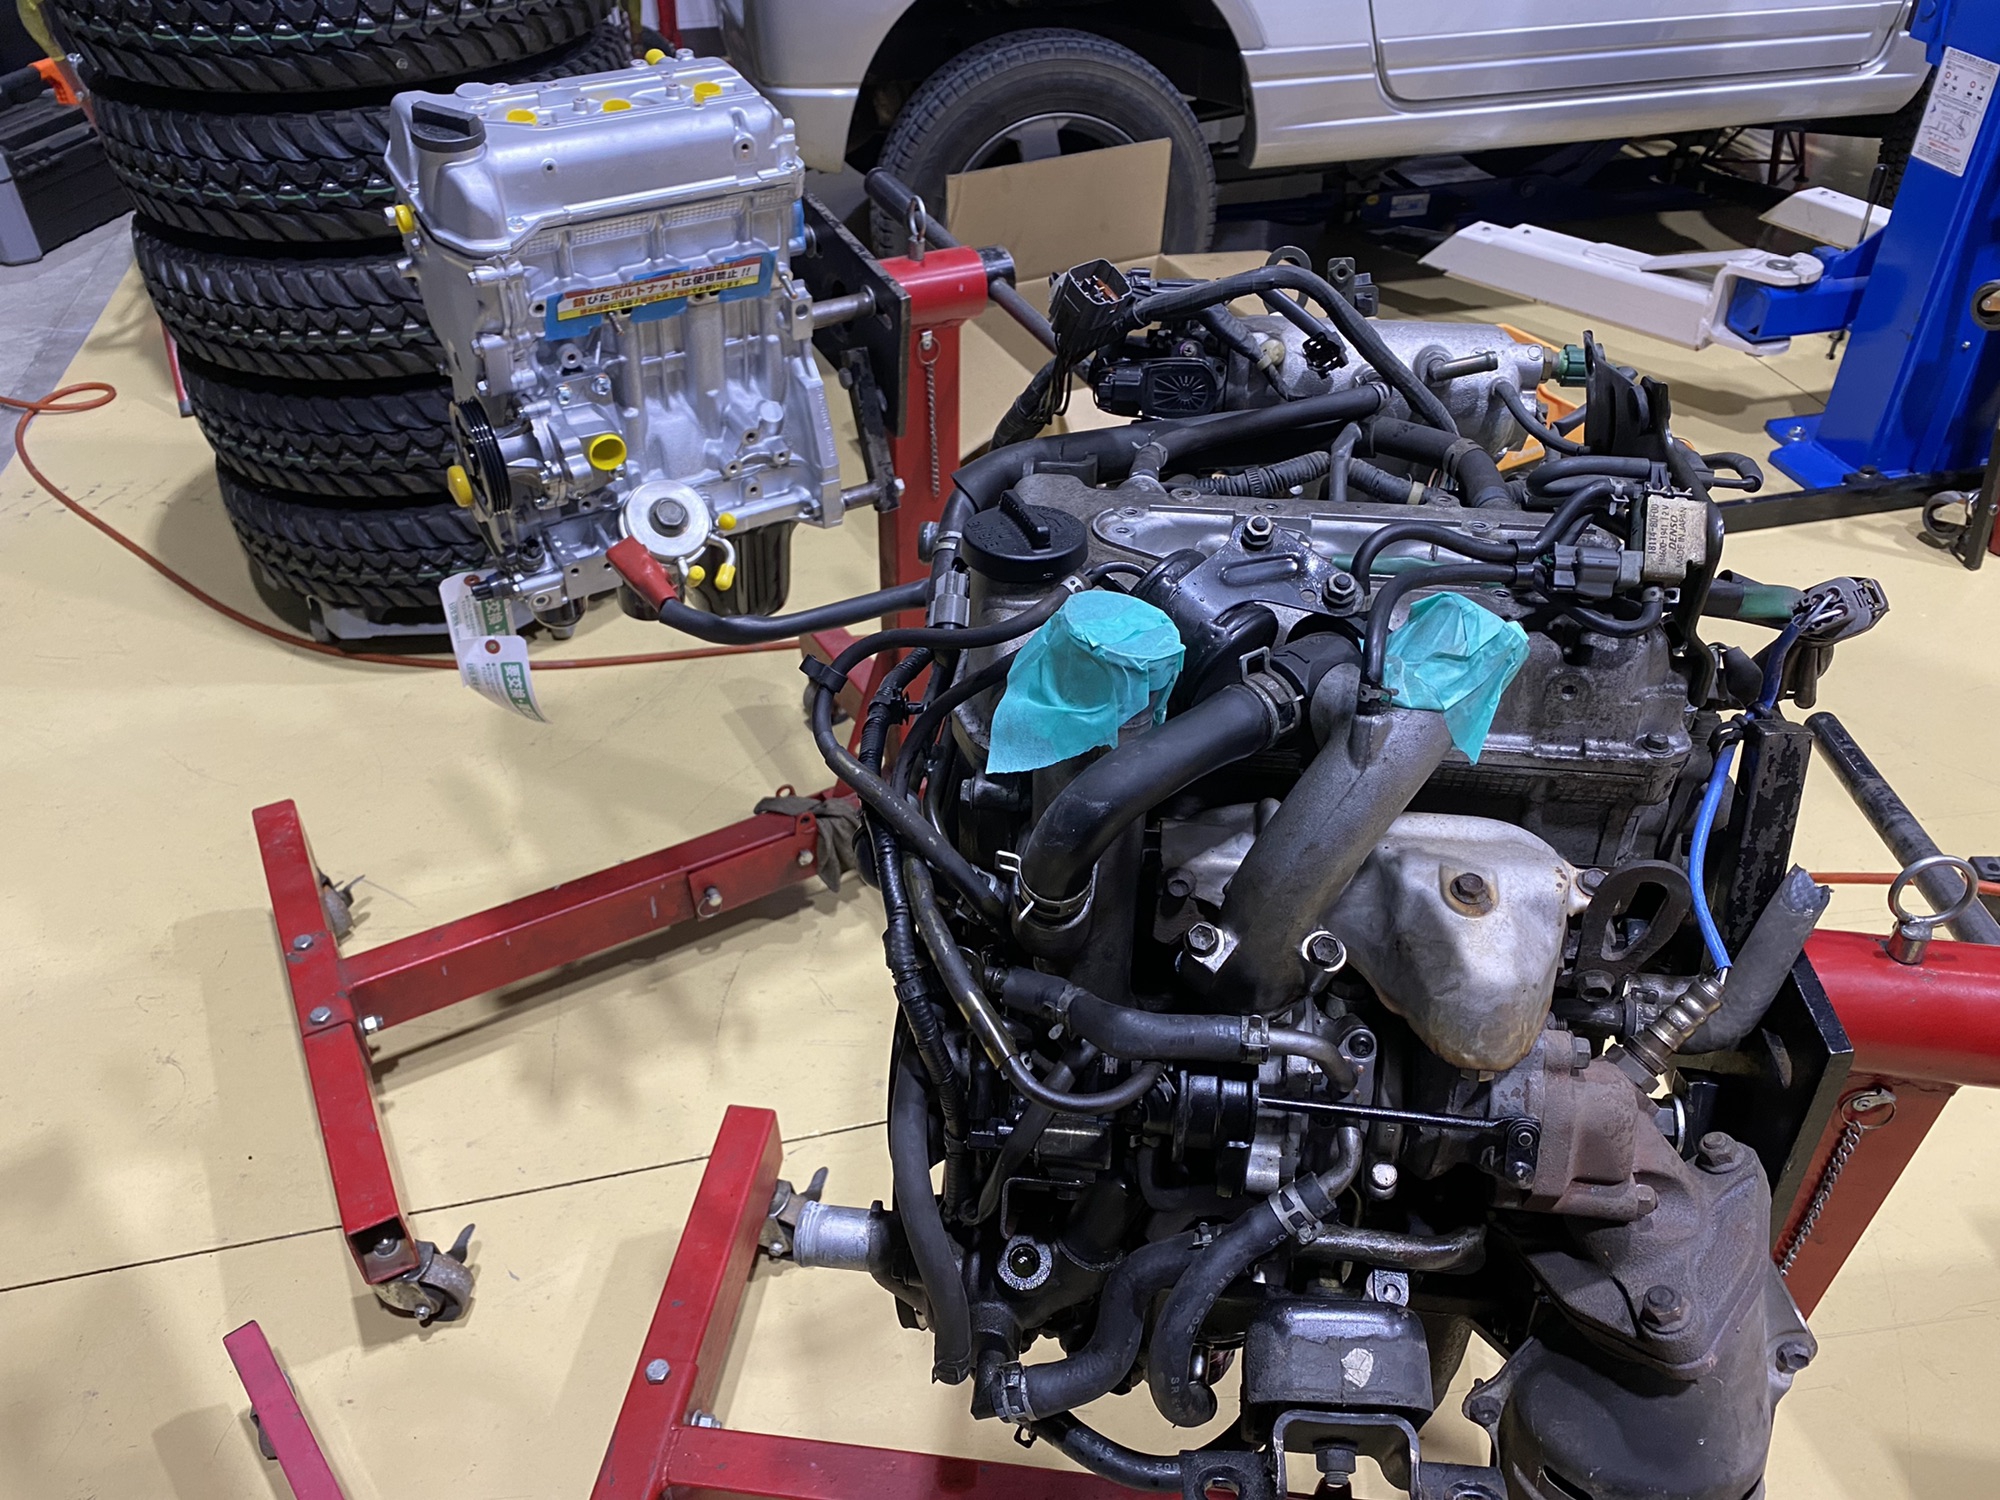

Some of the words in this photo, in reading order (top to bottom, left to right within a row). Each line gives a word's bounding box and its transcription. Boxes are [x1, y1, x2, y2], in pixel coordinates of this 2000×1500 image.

[1669, 515, 1678, 550] DENSO
[1678, 507, 1687, 534] JAPAN
[1677, 534, 1685, 542] IN
[1676, 544, 1685, 568] MADE
